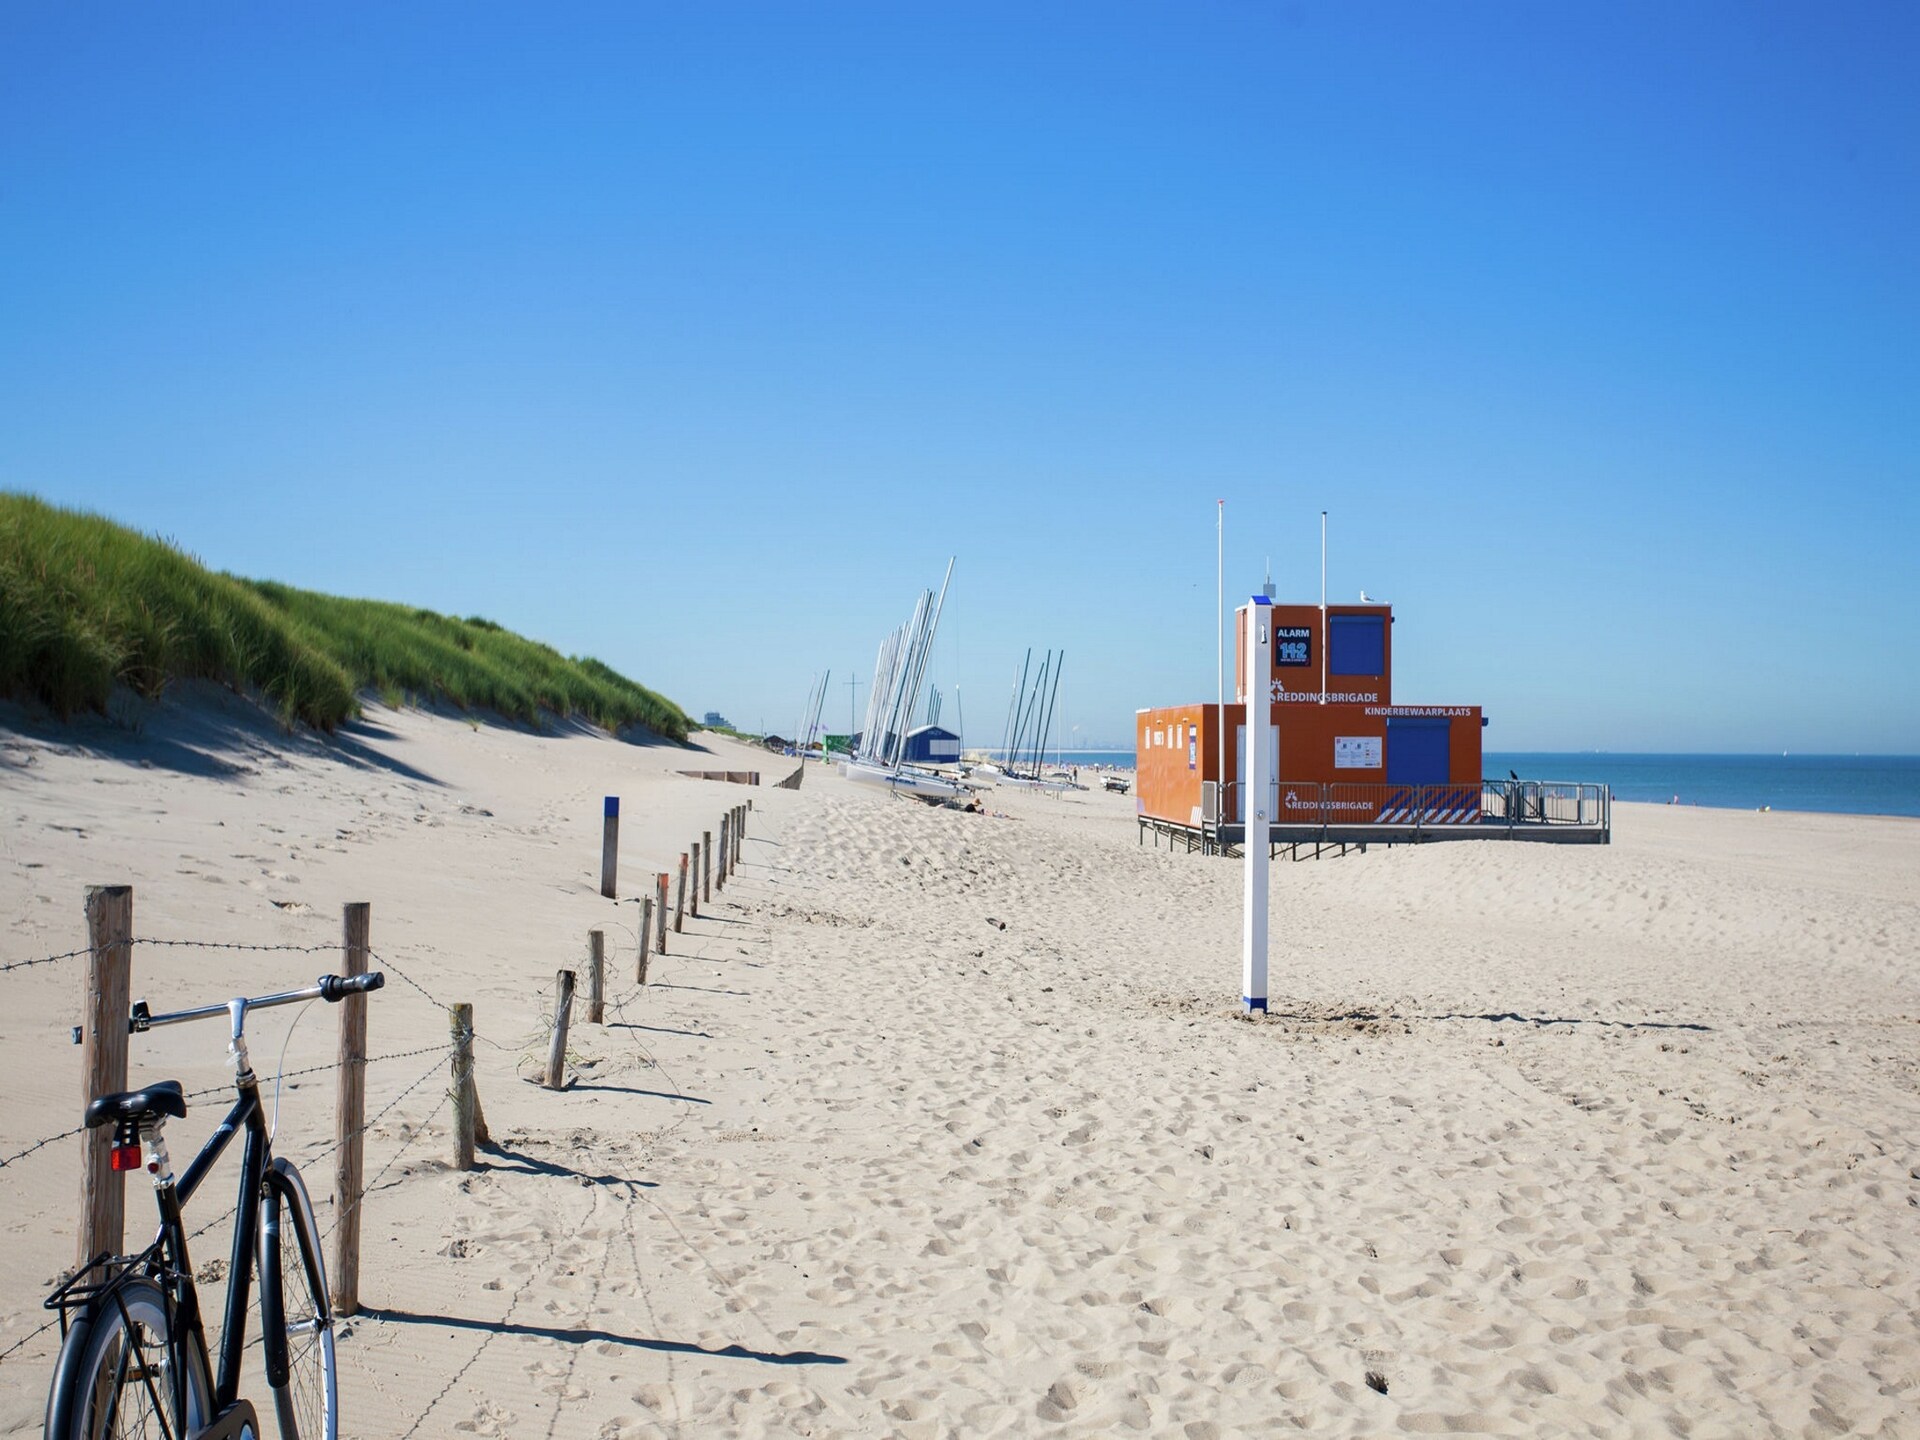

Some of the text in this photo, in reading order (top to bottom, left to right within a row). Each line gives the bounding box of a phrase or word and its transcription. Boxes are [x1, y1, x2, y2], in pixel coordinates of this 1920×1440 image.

[1278, 629, 1310, 638] ALARM
[1280, 642, 1307, 659] 112
[1365, 707, 1471, 716] KINDERBEWAARPLAATS
